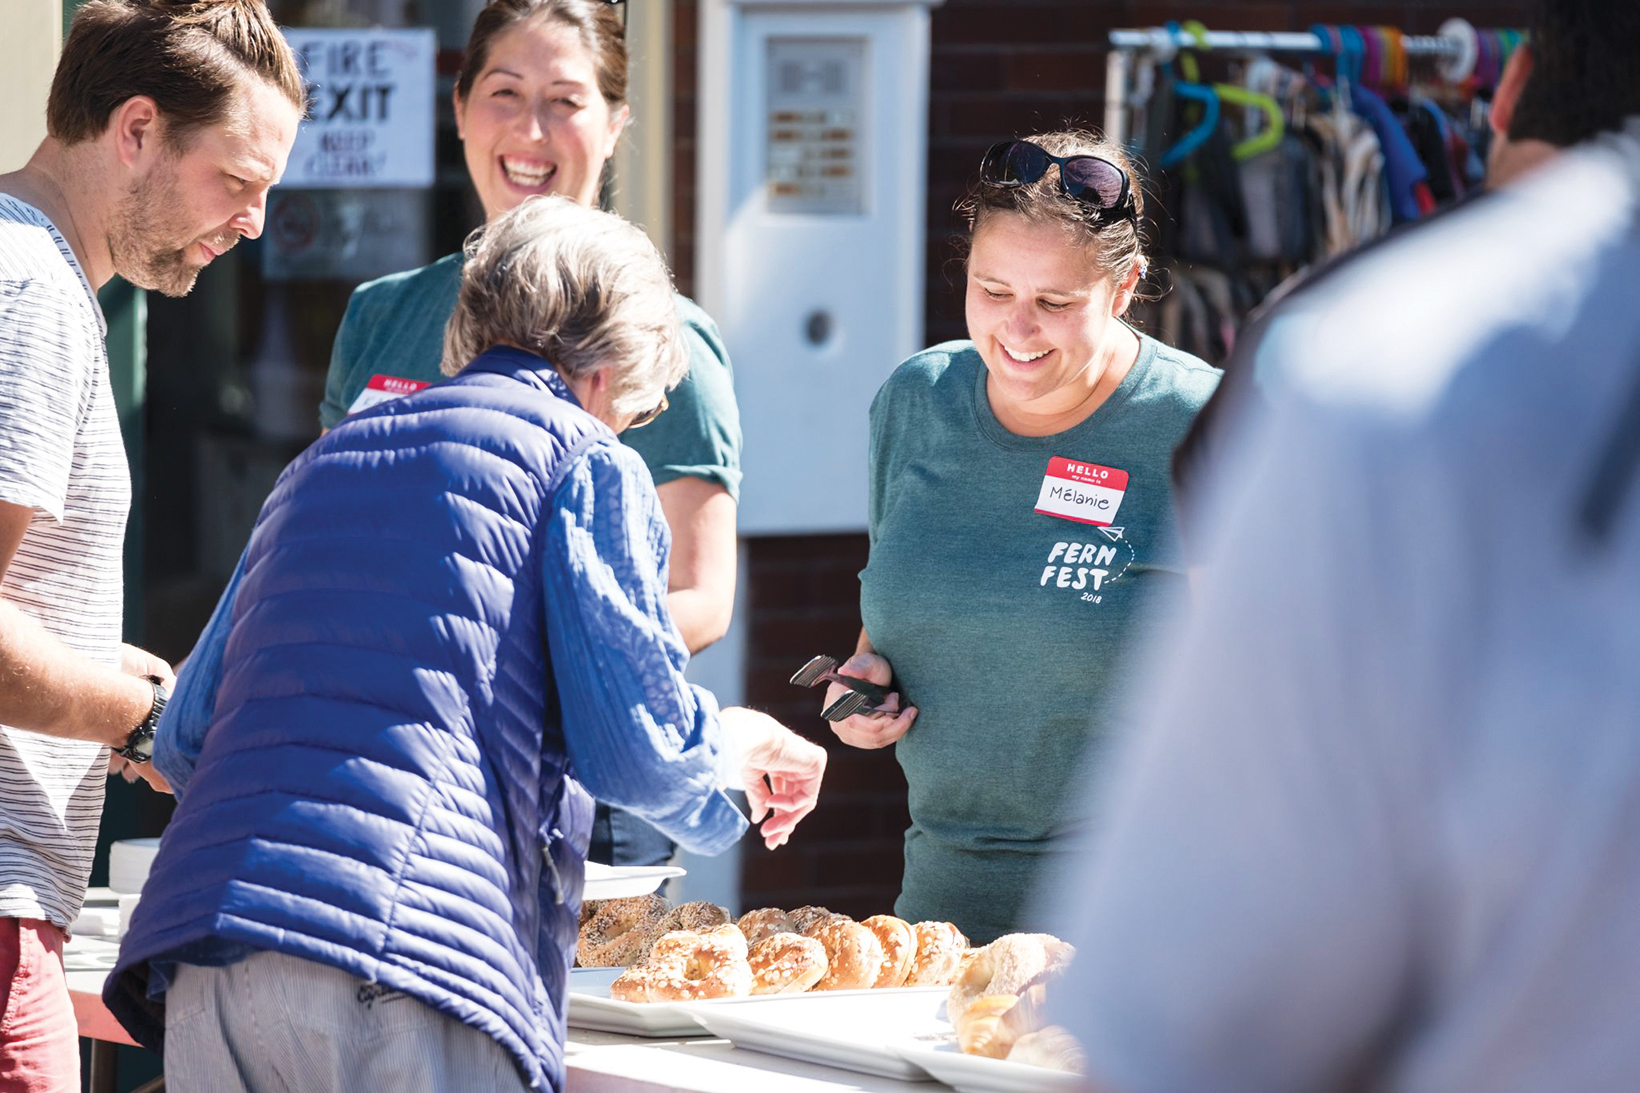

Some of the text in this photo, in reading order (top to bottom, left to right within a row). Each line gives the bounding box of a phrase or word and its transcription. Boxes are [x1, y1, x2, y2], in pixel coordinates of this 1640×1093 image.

[302, 40, 389, 76] FIRE
[1067, 463, 1108, 479] HELLO
[1049, 486, 1110, 510] Mélanie
[1047, 541, 1117, 566] FERN
[1040, 566, 1109, 591] FEST
[1080, 592, 1102, 604] 2018
